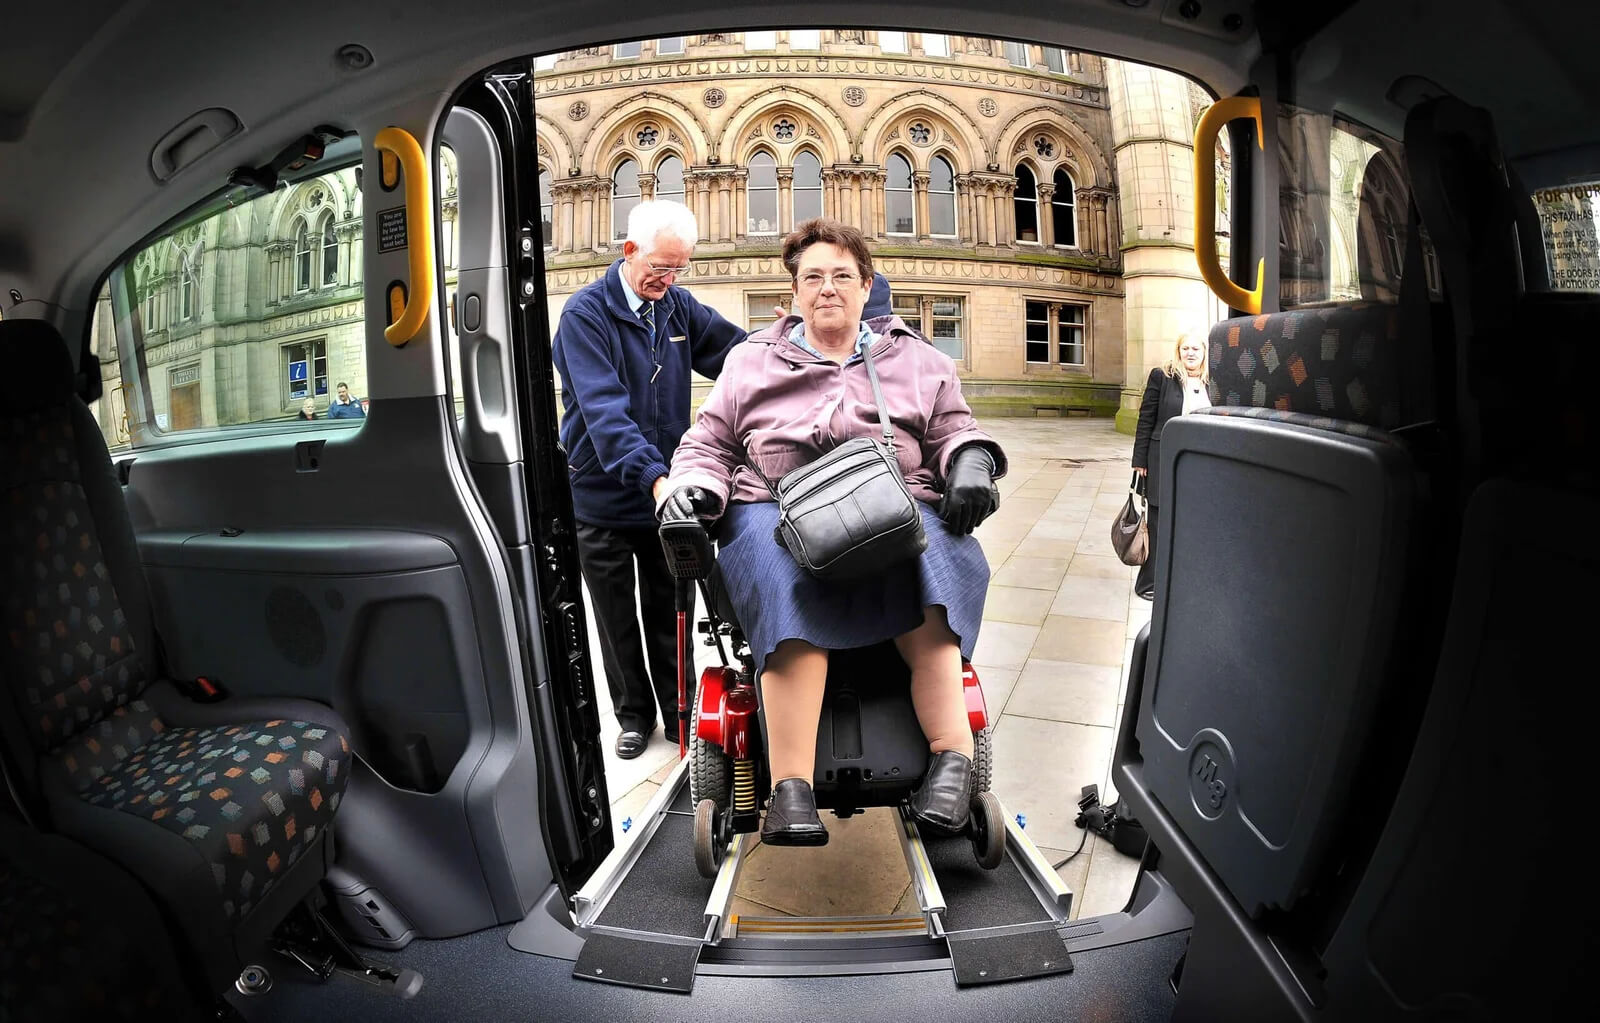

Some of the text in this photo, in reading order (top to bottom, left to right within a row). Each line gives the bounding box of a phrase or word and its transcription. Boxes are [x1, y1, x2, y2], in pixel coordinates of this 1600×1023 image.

[1536, 184, 1600, 204] FOR YOUR
[1540, 209, 1593, 223] THIS TAXI HAS
[1551, 269, 1565, 278] THE
[1567, 268, 1592, 278] DOORS
[1560, 279, 1587, 289] MOTION
